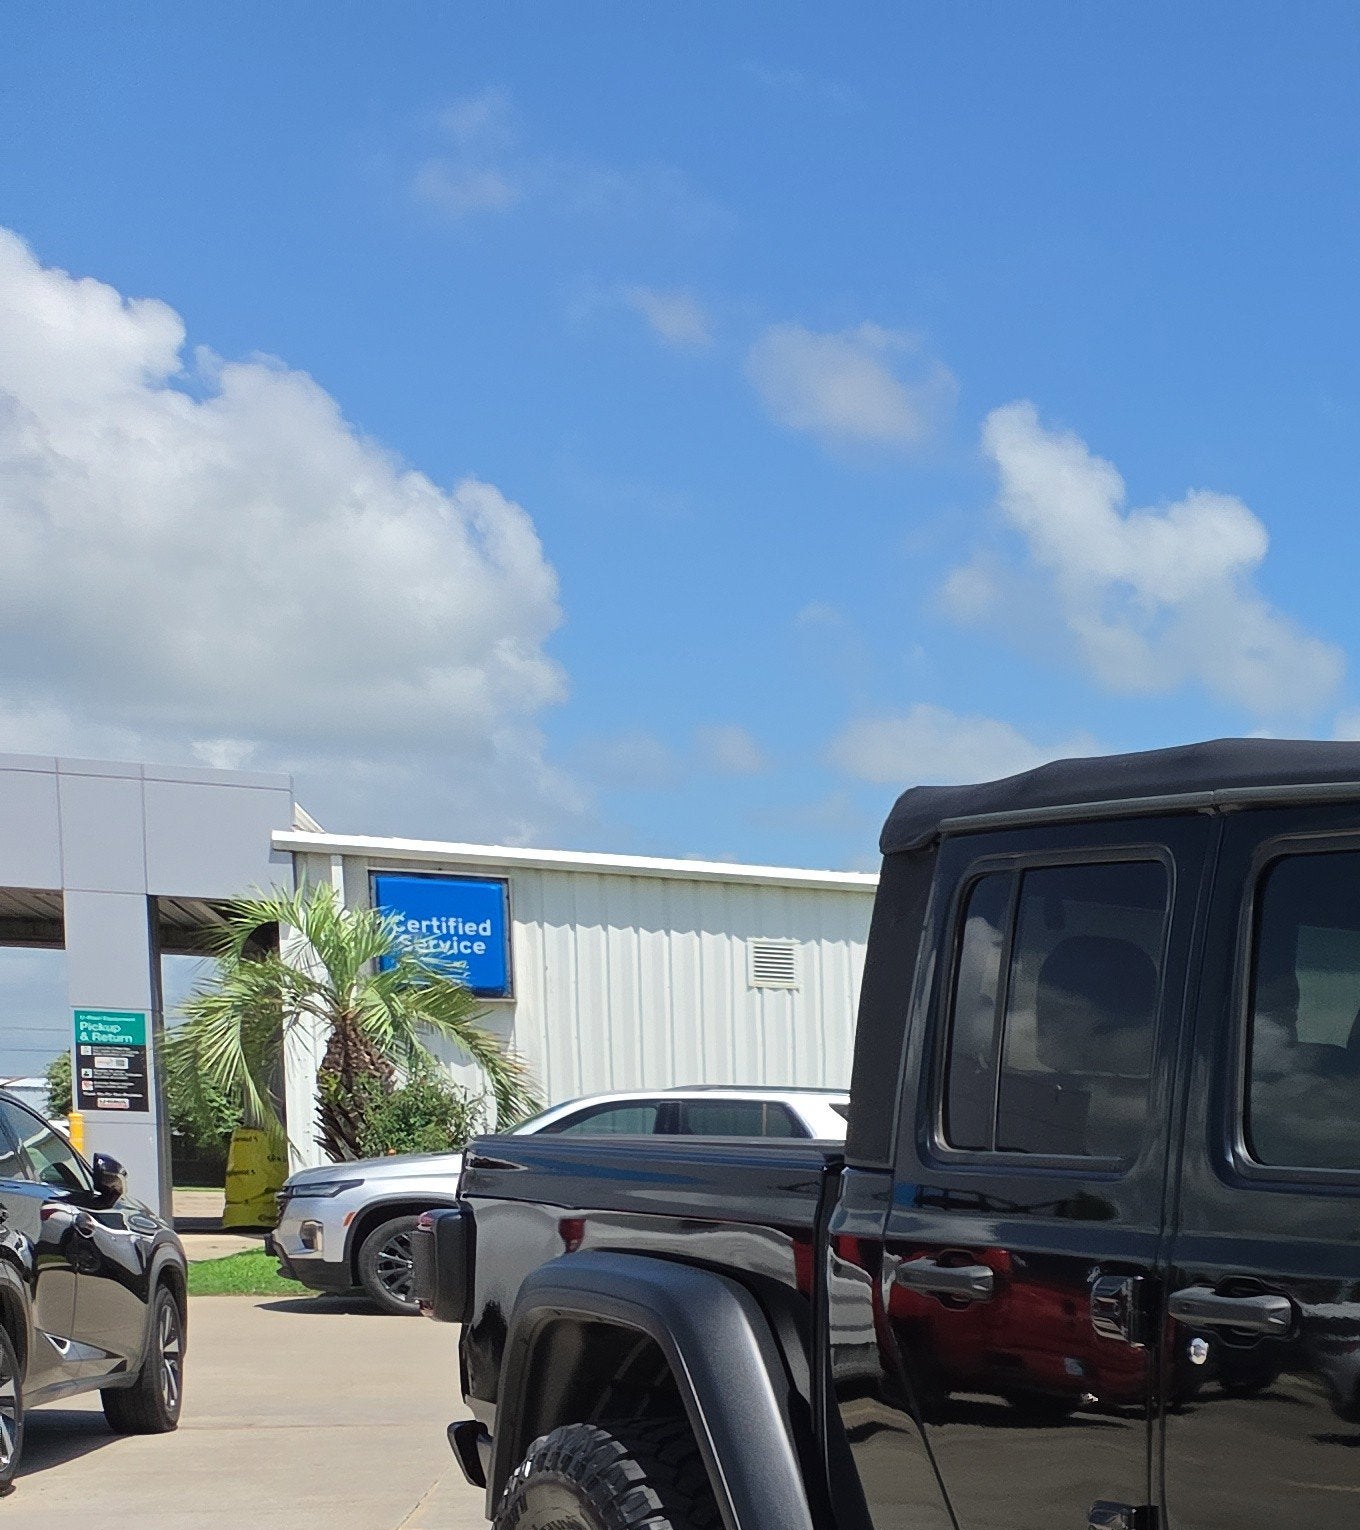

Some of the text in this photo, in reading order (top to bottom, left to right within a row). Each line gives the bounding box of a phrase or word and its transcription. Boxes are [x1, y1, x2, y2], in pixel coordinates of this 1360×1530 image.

[391, 915, 491, 936] Certified
[399, 934, 486, 955] Service
[80, 1021, 122, 1034] Pickup
[92, 1032, 133, 1044] Return
